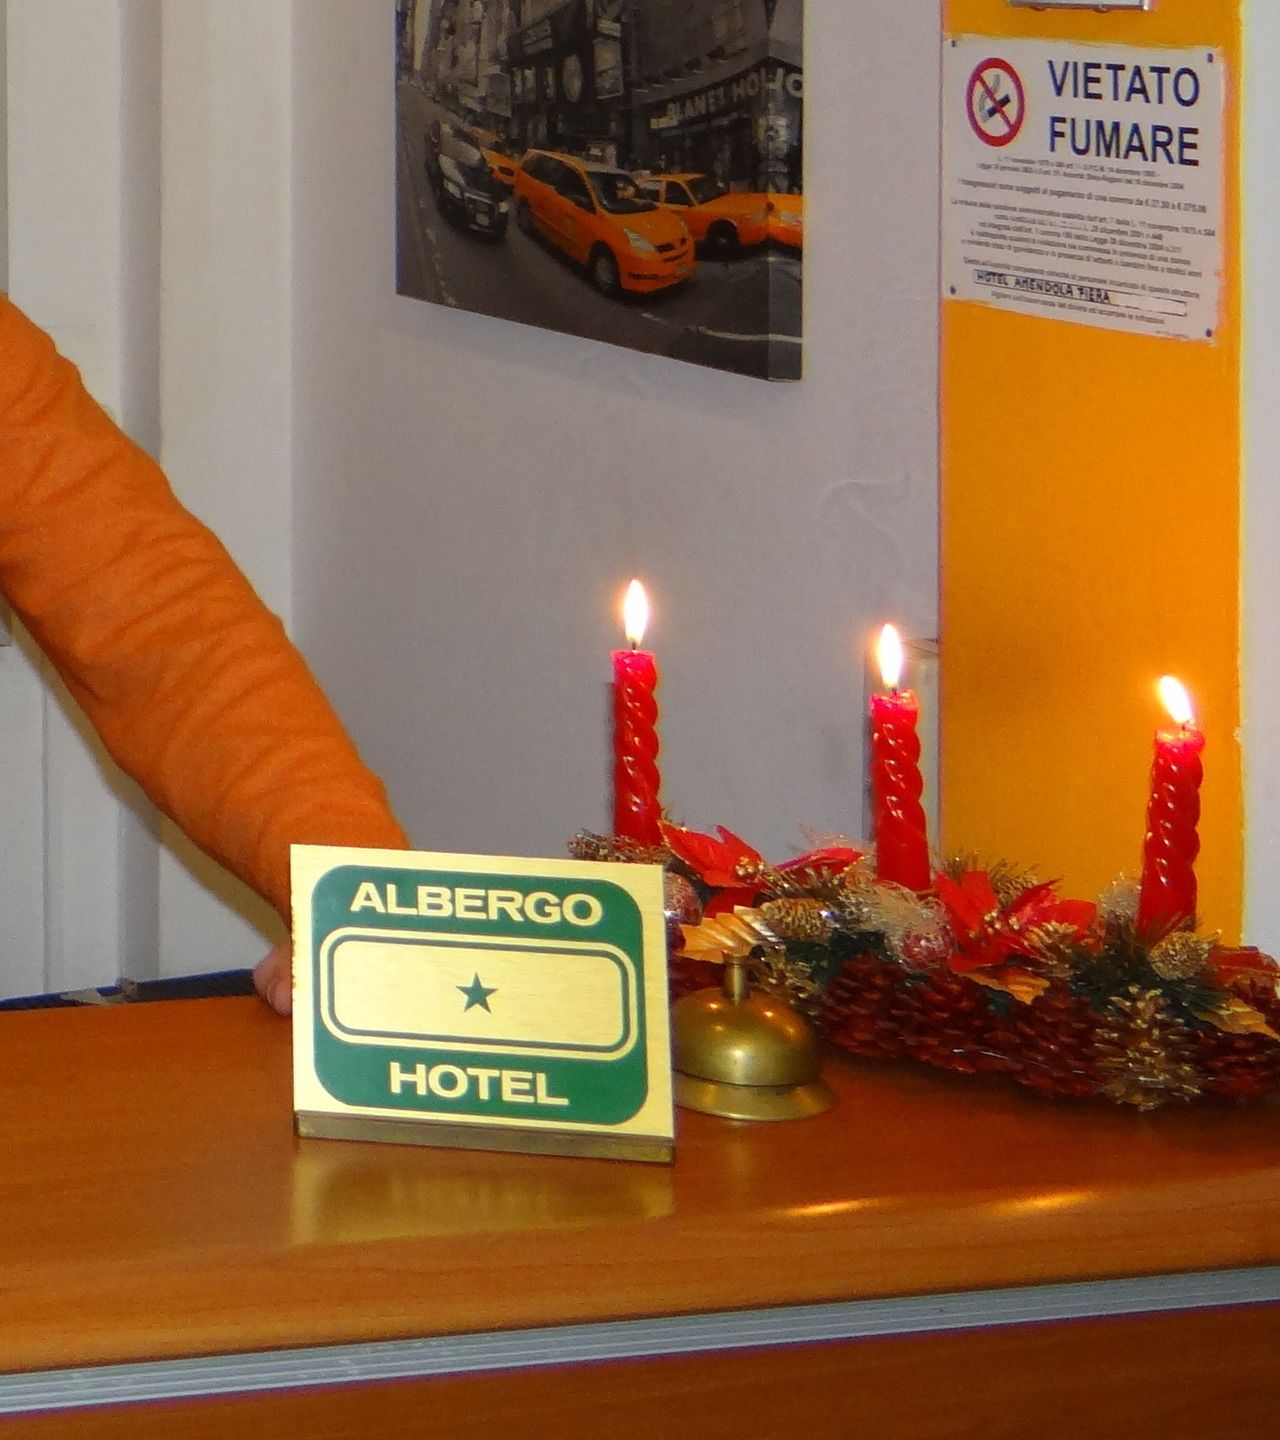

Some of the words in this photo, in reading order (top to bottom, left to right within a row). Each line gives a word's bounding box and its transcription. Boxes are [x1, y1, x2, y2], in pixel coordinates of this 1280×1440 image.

[1048, 60, 1201, 107] VIETATO
[1049, 116, 1200, 166] FUMARE
[975, 270, 1009, 286] HOTEL
[1013, 277, 1074, 297] AMENDOLA
[349, 882, 603, 927] ALBERGO
[389, 1061, 571, 1106] HOTEL
